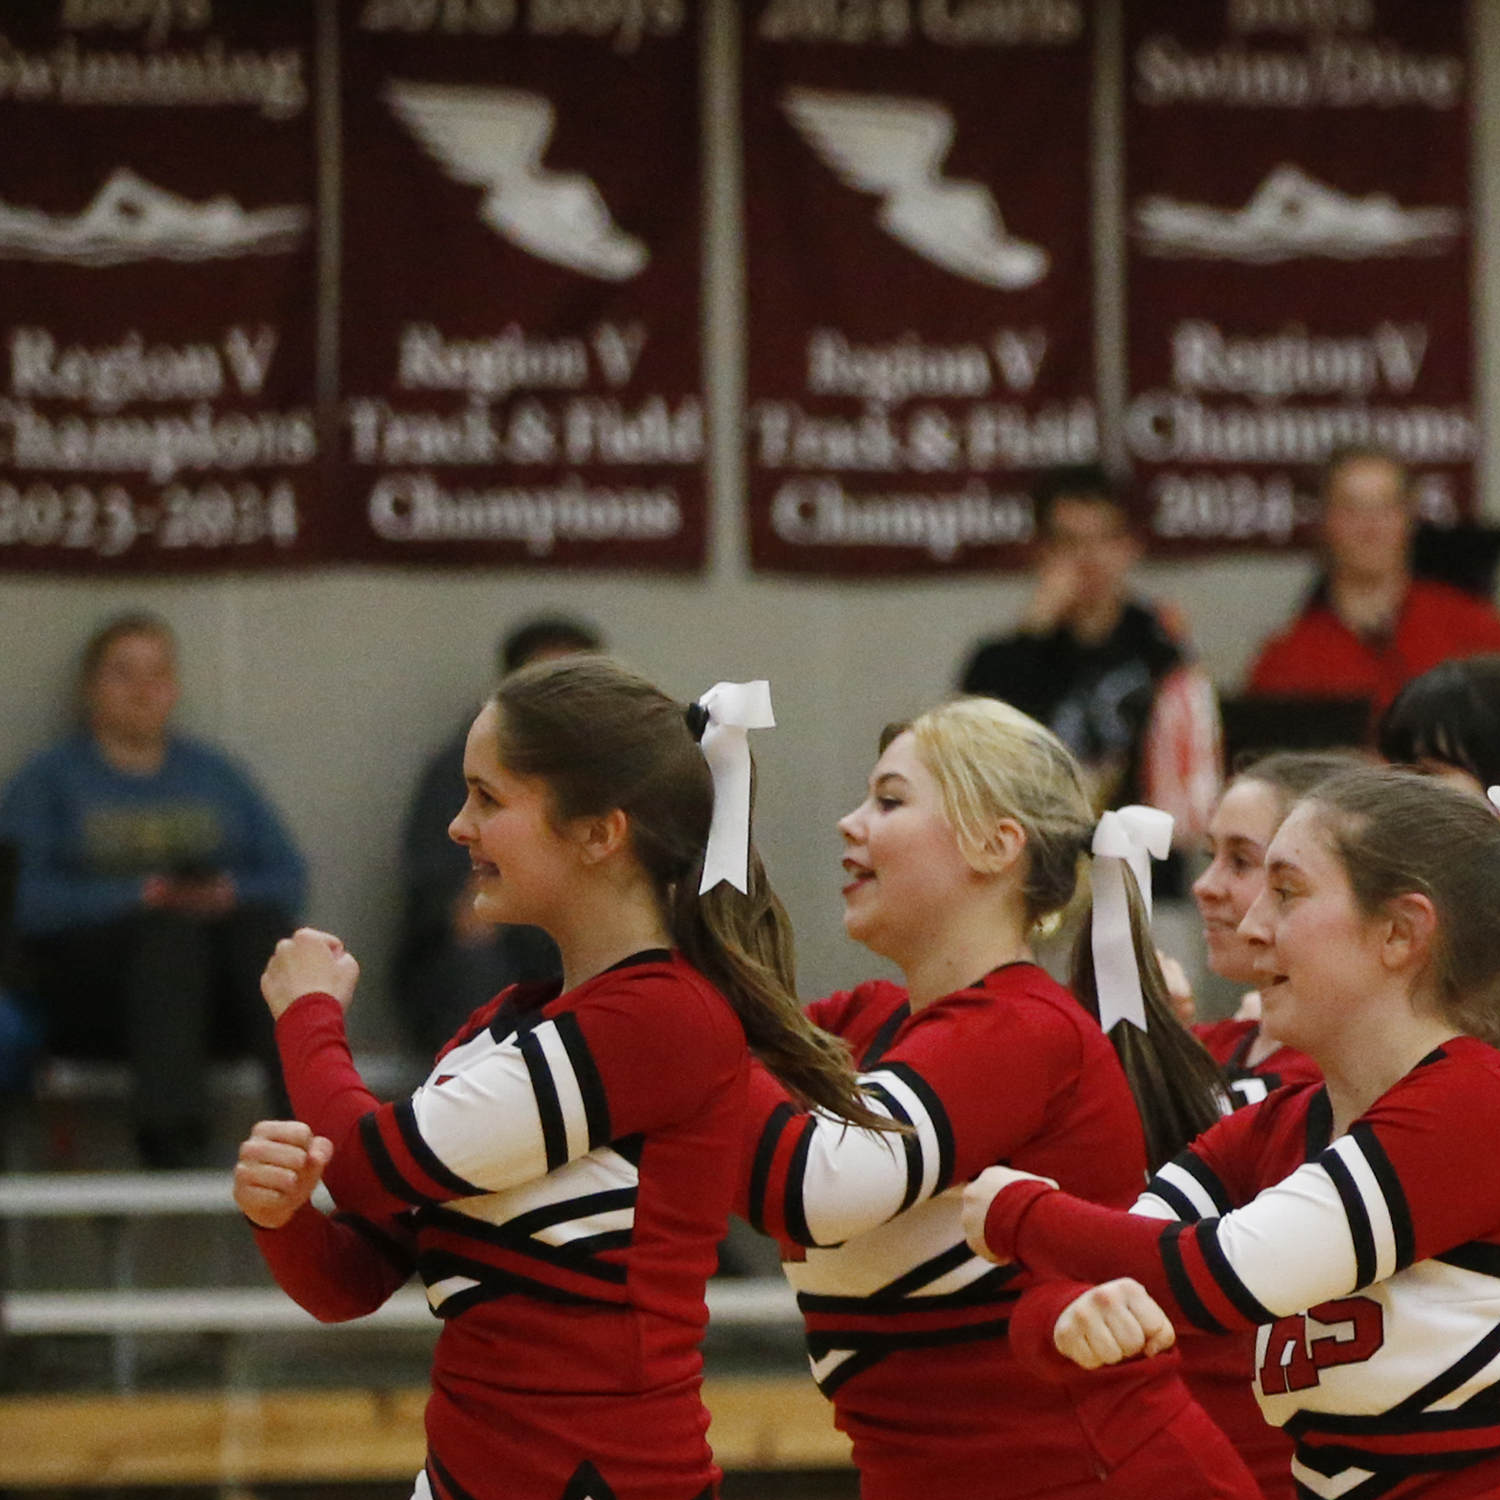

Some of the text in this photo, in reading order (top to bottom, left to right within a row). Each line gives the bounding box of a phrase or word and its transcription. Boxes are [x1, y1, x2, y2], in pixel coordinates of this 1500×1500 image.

[11, 323, 277, 411] Region V
[399, 322, 647, 399] Region V
[807, 325, 1047, 403] Region V
[1172, 320, 1429, 401] Region V
[0, 403, 318, 484] hampions
[351, 397, 702, 464] Track & Field
[753, 399, 1099, 471] Track & Field
[368, 474, 683, 556] Champions
[770, 475, 1038, 561] Champio
